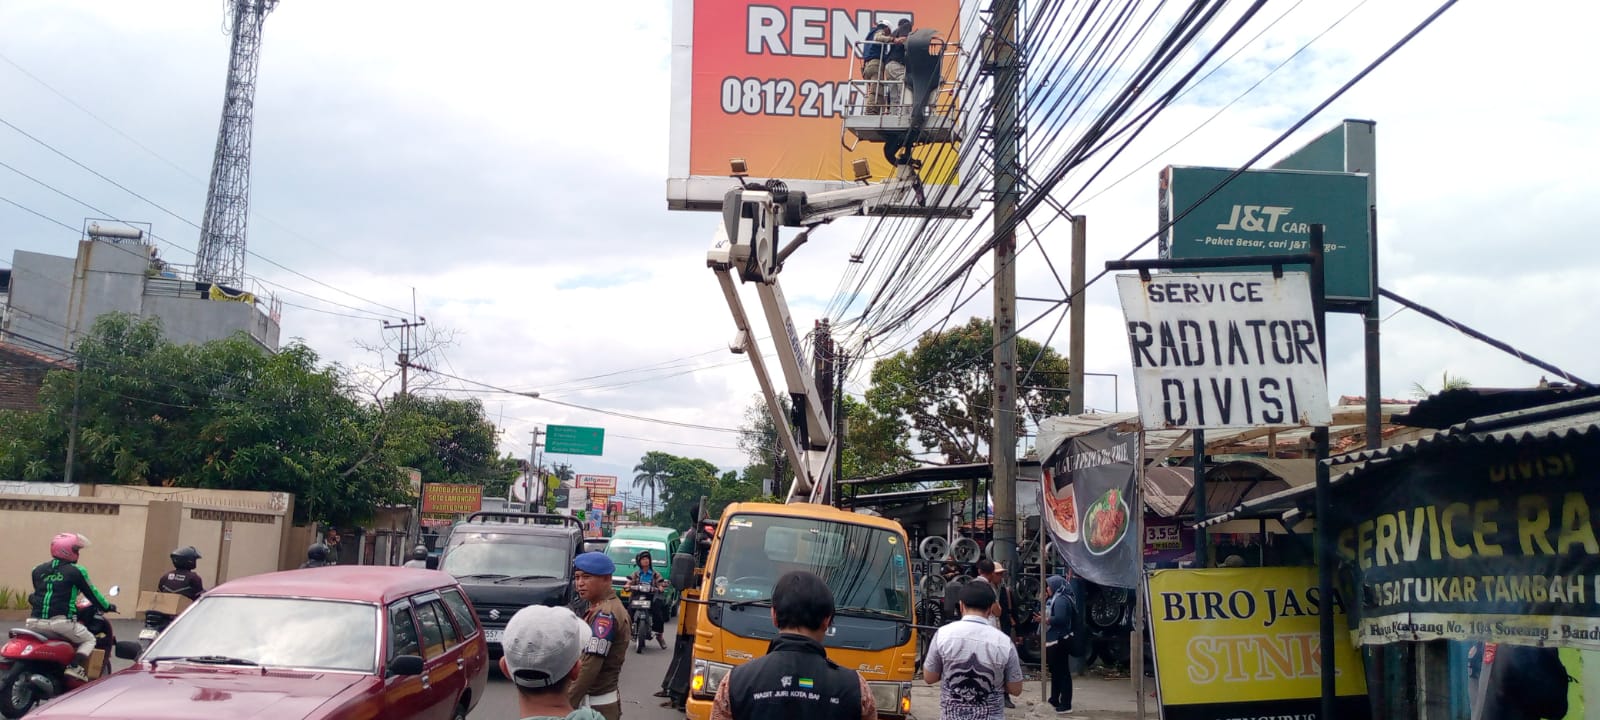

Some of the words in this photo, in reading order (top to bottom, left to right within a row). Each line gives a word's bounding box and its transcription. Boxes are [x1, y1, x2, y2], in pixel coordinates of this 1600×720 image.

[746, 5, 913, 58] RENT
[721, 76, 795, 116] 0812
[1216, 205, 1294, 233] J&T
[1281, 222, 1326, 234] CAR
[1205, 236, 1234, 246] Paket
[1236, 238, 1266, 249] Besar,
[1268, 239, 1287, 249] cari
[1288, 241, 1307, 250] J&T
[1148, 282, 1264, 304] SERVICE
[1128, 319, 1319, 368] RADIATOR
[1161, 377, 1299, 426] DIVISI
[1148, 527, 1167, 540] 3.5
[1337, 498, 1504, 572] SERVICE
[1480, 575, 1585, 603] TAMBAH
[1160, 589, 1256, 622] BIRO
[1446, 620, 1465, 633] No.
[1561, 624, 1600, 641] Band
[753, 691, 772, 700] WASIT
[790, 690, 807, 698] KOTA
